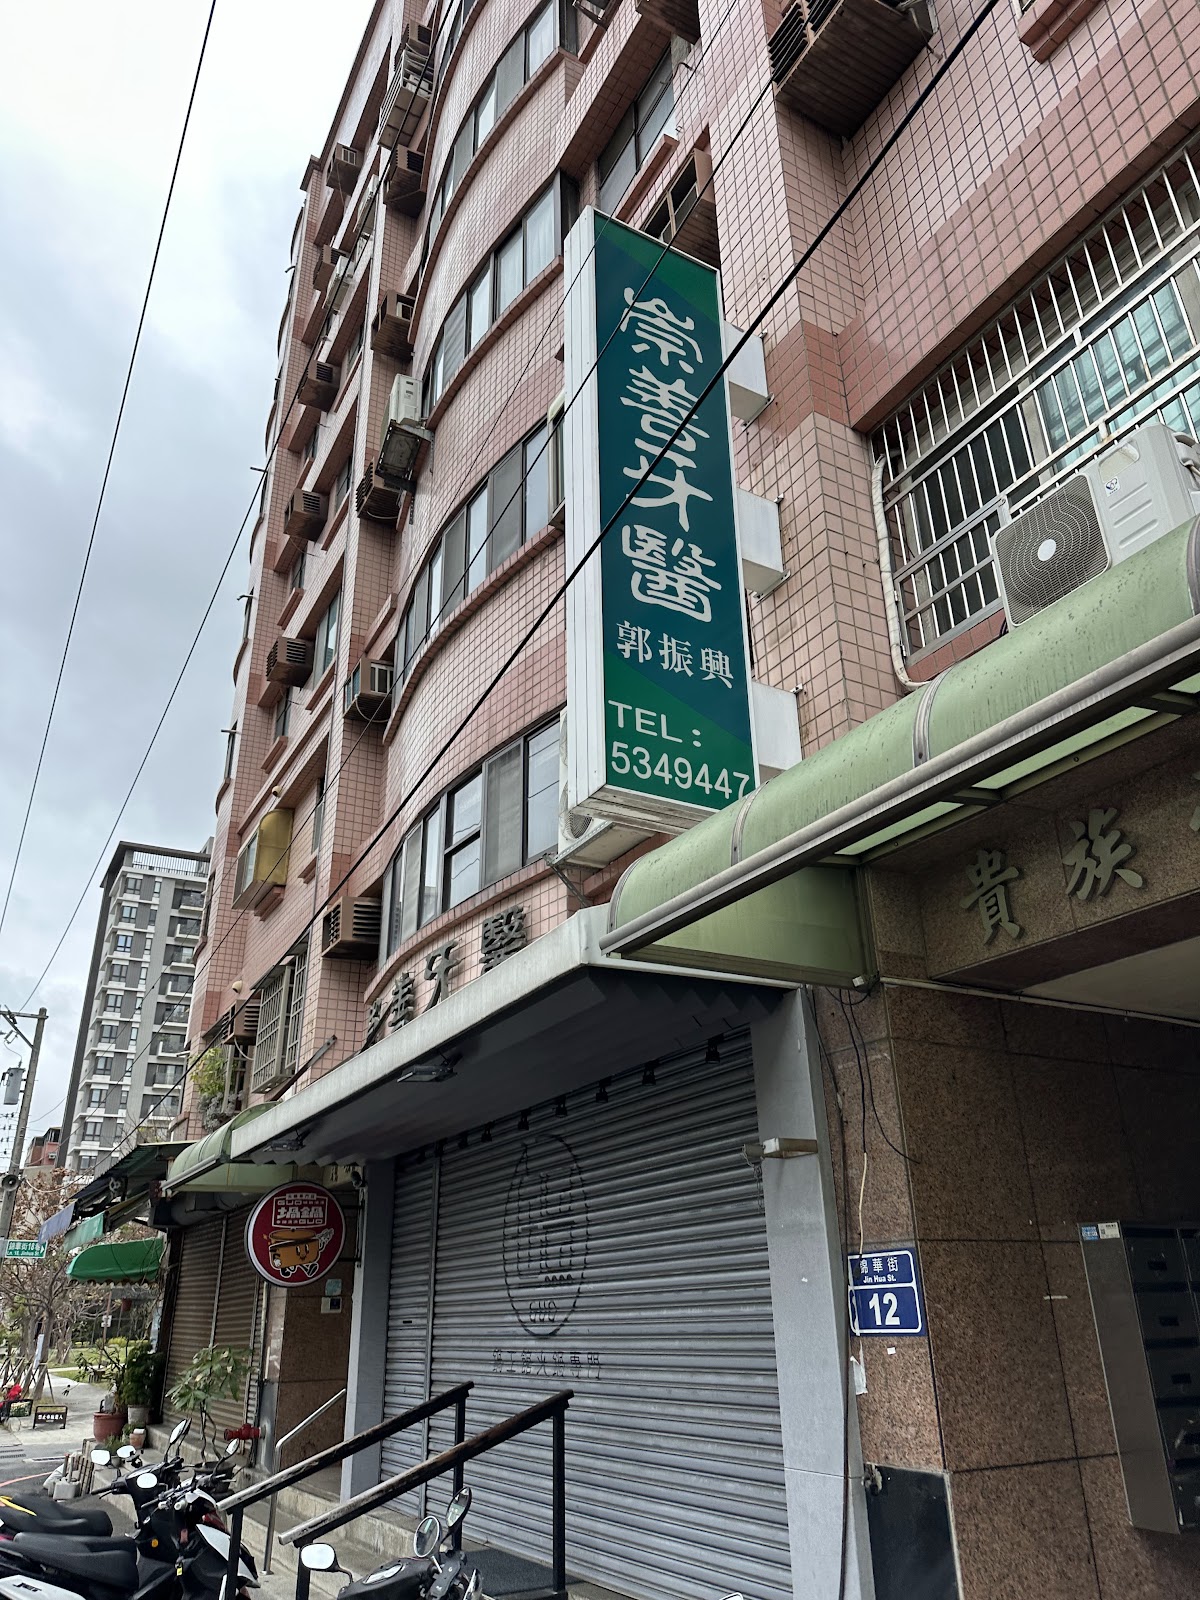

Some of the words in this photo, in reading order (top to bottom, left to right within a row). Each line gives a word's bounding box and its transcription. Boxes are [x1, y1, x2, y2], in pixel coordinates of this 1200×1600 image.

[619, 286, 724, 624] 崇善牙醫
[615, 619, 734, 690] 郭振興
[610, 740, 750, 800] 5349447
[959, 771, 1200, 946] 貴族
[857, 1256, 899, 1275] 錦華街
[862, 1275, 873, 1284] Jin
[874, 1275, 886, 1283] Hua
[887, 1274, 897, 1282] St.
[868, 1292, 901, 1326] 12
